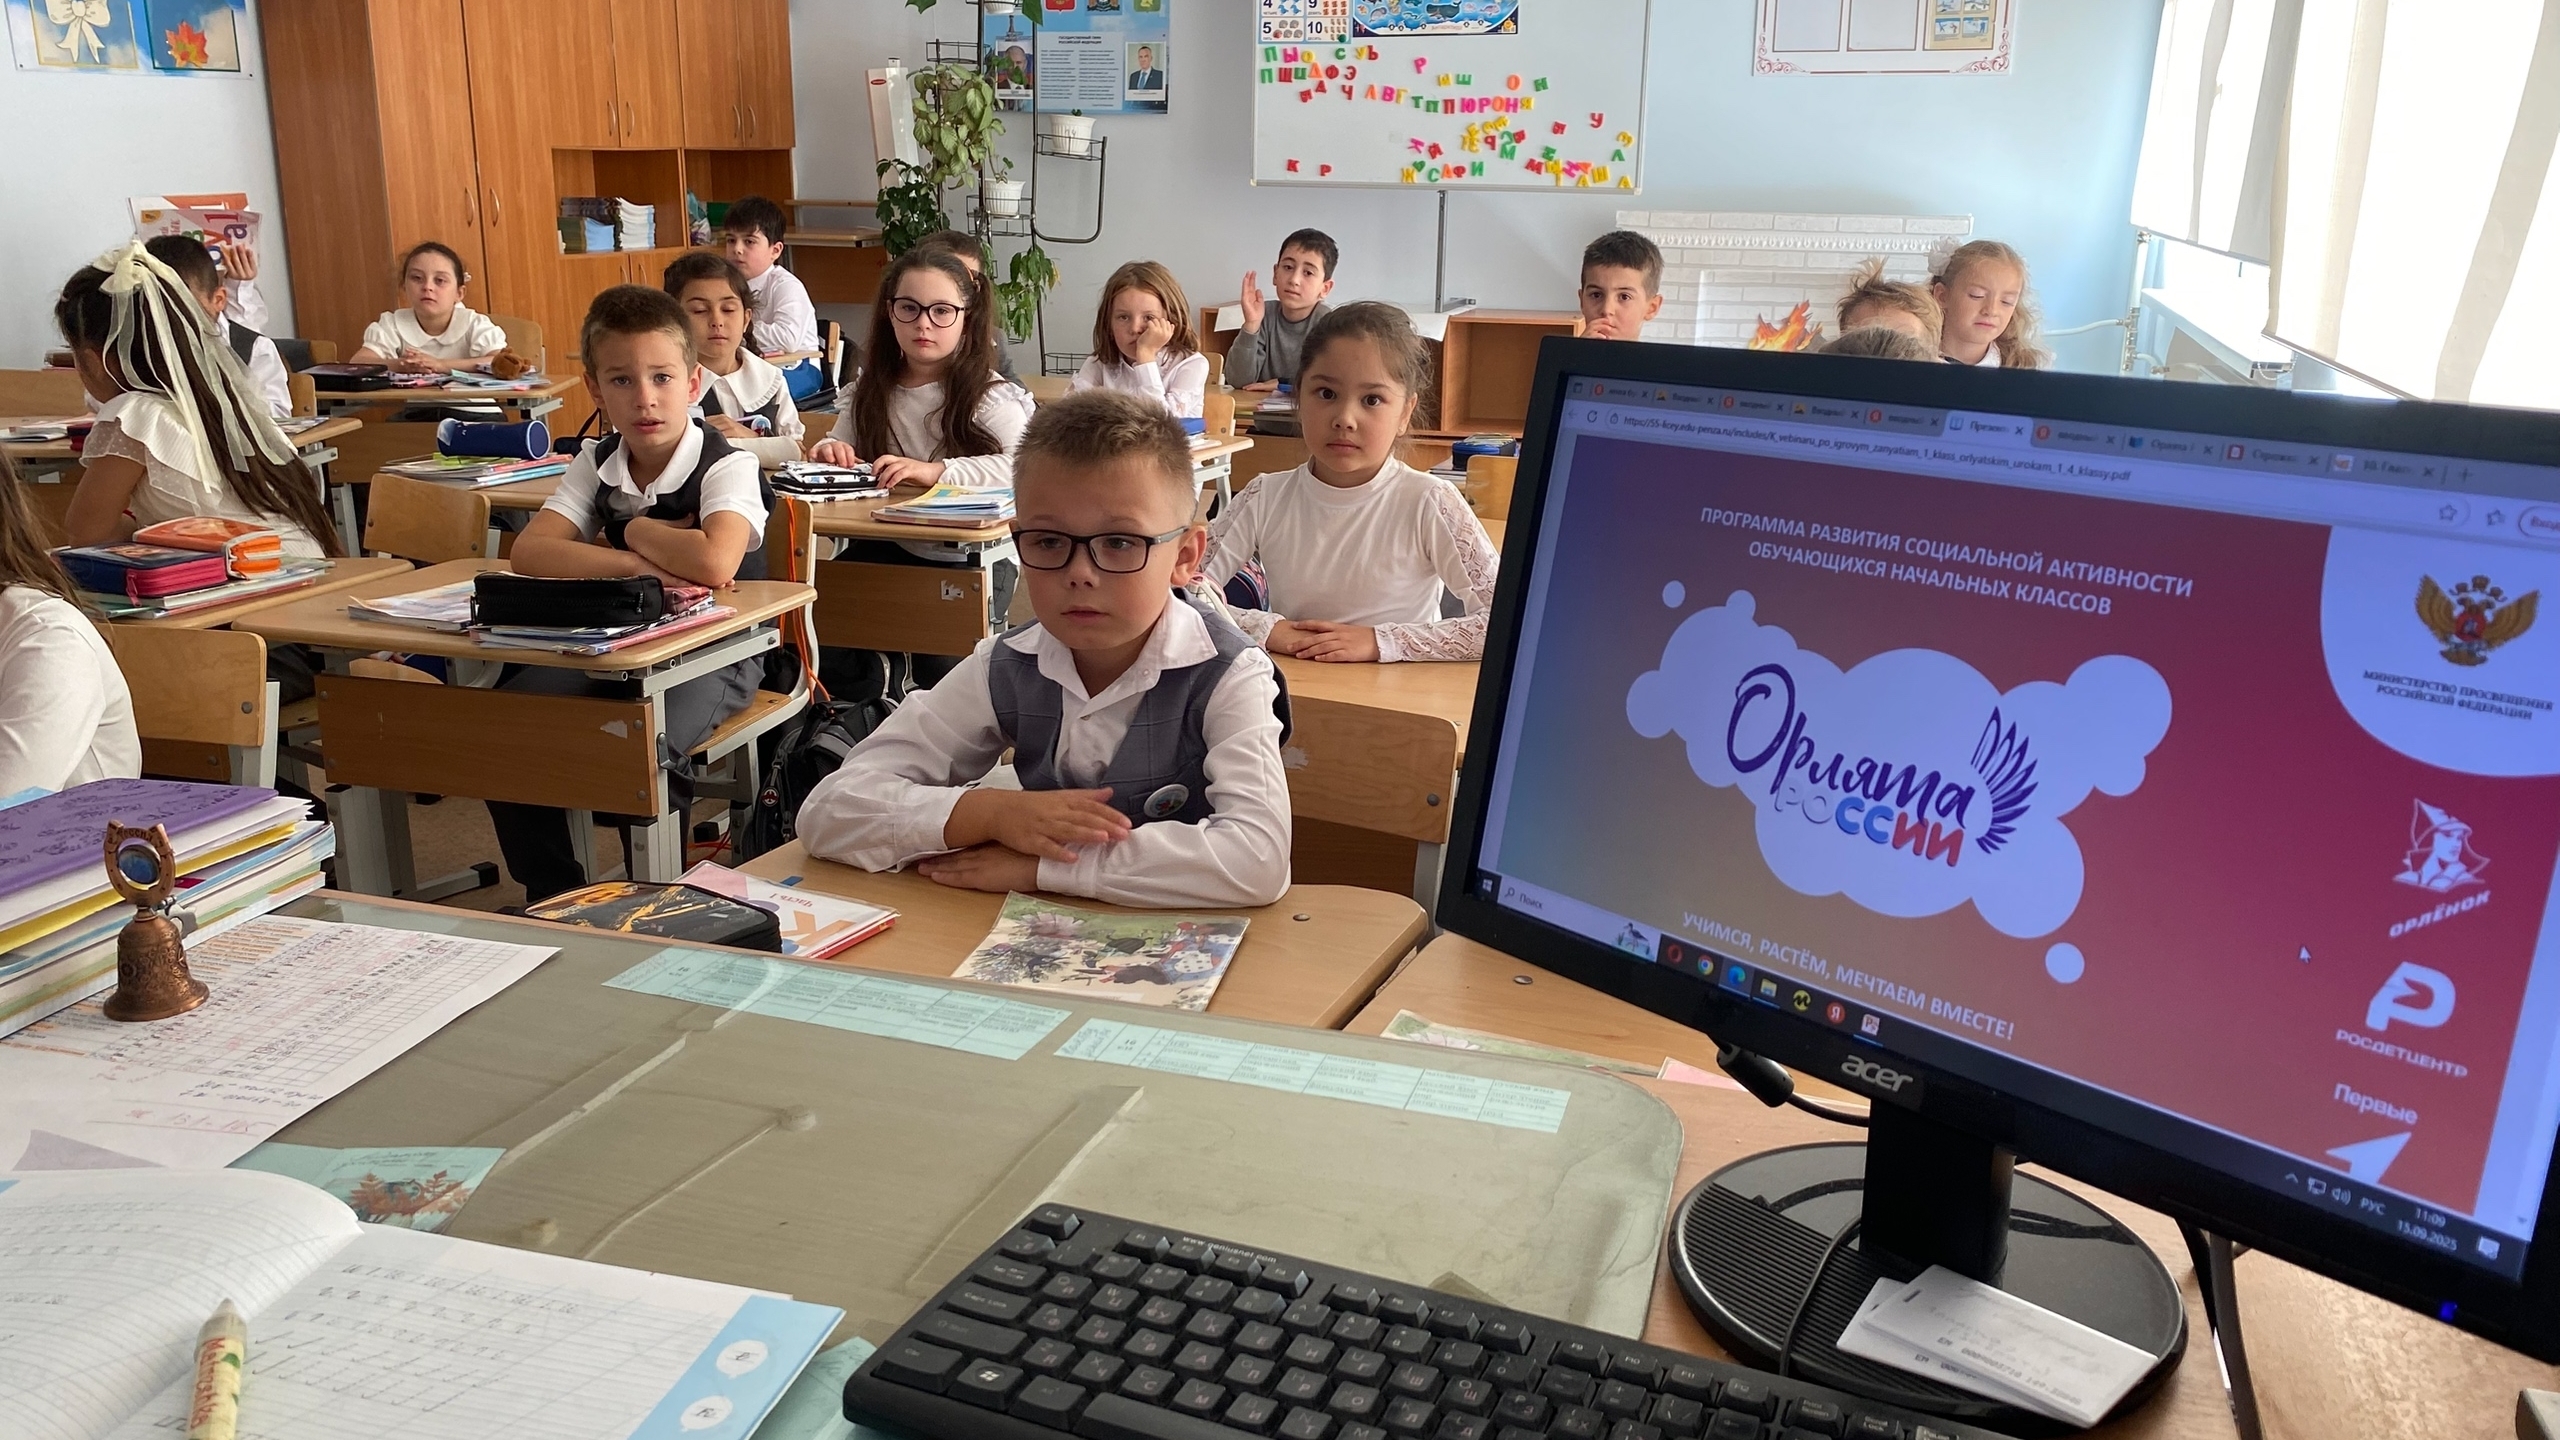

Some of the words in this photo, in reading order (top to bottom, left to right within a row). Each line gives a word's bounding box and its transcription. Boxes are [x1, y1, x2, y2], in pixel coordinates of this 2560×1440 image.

[1262, 22, 1272, 34] 5
[1307, 21, 1322, 34] 10
[1700, 507, 1805, 539] ПРОГРАММА
[1810, 523, 1900, 552] РАЗВИТИЯ
[1905, 537, 2042, 574] СОЦИАЛЬНОЙ
[2047, 558, 2193, 597] АКТИВНОСТИ
[1749, 541, 1886, 578] ОБУЧАЮЩИХСЯ
[1890, 564, 2010, 598] НАЧАЛЬНЫХ
[2015, 584, 2112, 616] КЛАССОВ
[2363, 669, 2457, 694] МИНИСТЕРСТВО
[2459, 687, 2553, 711] ПРОСВЕЩЕНИЯ
[2377, 684, 2455, 707] РОССИЙСКОЙ
[2458, 699, 2532, 720] ФЕДЕРАЦИИ
[1727, 663, 1976, 829] Орлята
[1519, 893, 1543, 910] Поиск
[2389, 890, 2491, 938] ОРЛЁНОК
[1682, 910, 1756, 955] УЧИМСЯ,
[1758, 935, 1830, 982] РАСТЁМ,
[1836, 967, 1926, 1009] МЕЧТАЕМ
[1930, 996, 2015, 1040] ВМЕСТЕ!
[2336, 1029, 2468, 1077] РОСДЕТЦЕНТР
[1840, 1054, 1914, 1094] acer
[2334, 1082, 2418, 1125] Первые
[2360, 1197, 2386, 1216] РУС
[2416, 1207, 2446, 1228] 11:09
[2397, 1219, 2458, 1251] 15.09.2025
